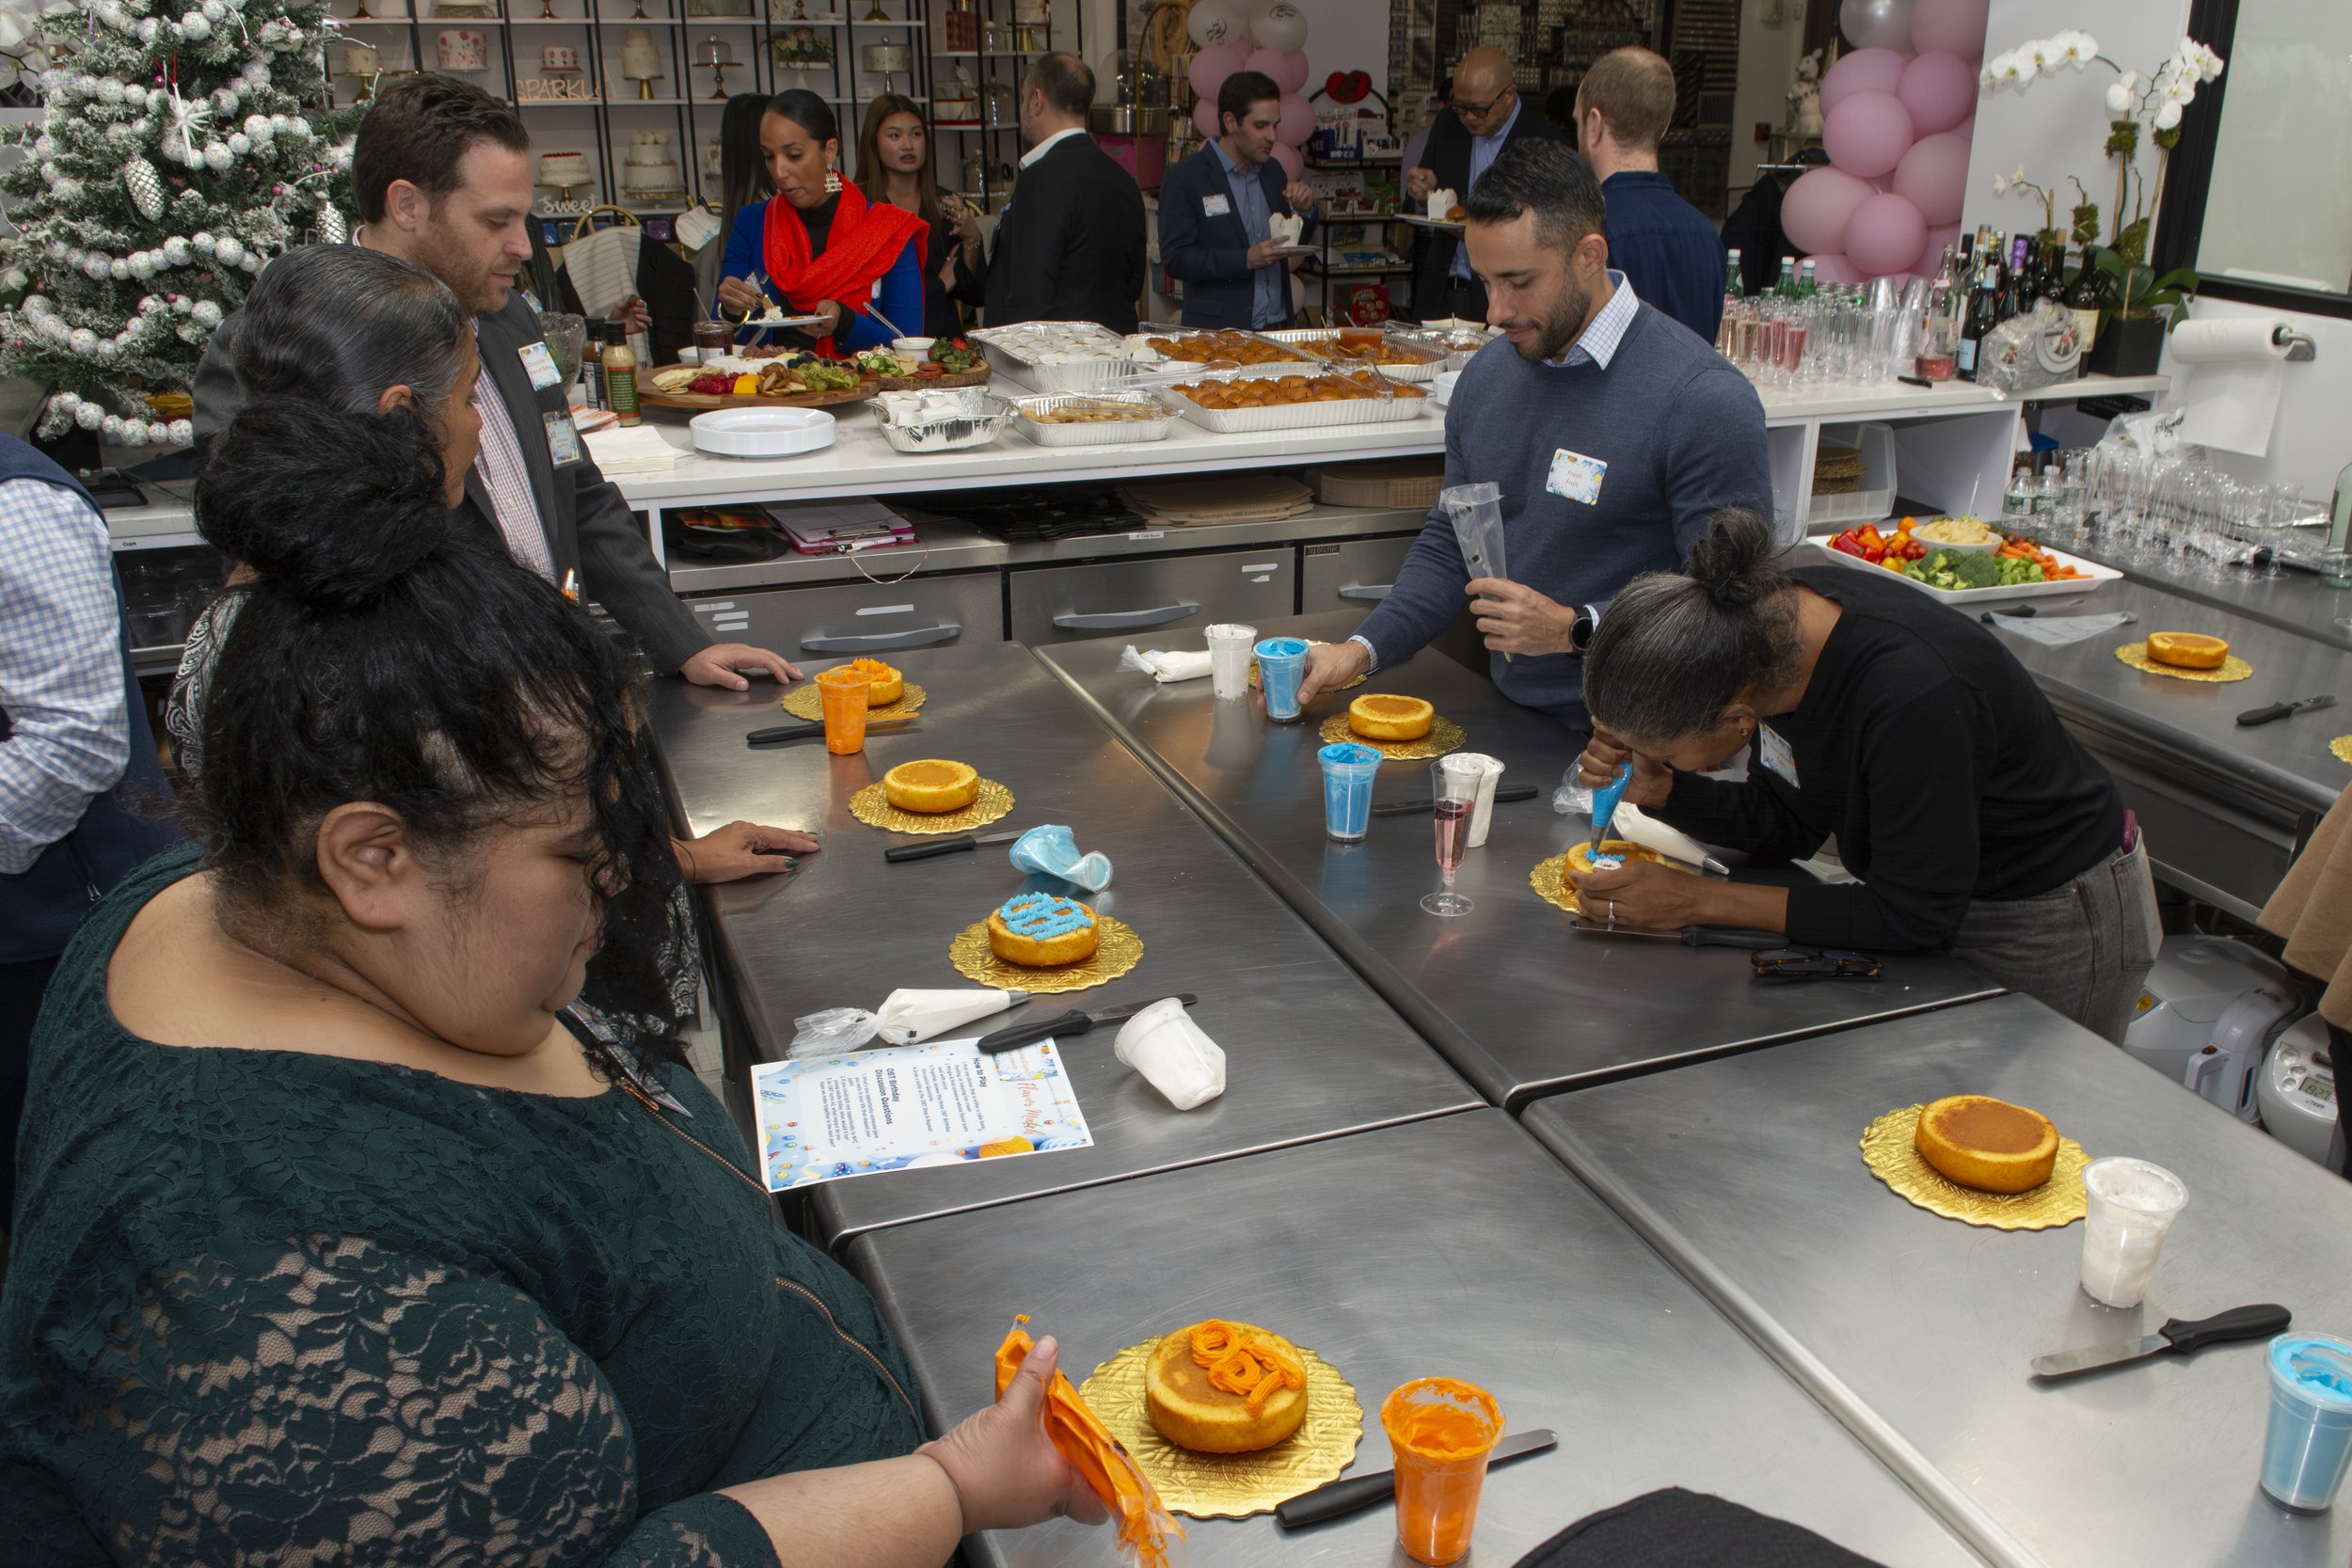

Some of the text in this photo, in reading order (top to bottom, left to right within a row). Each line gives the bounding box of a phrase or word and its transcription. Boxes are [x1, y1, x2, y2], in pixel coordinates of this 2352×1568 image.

[538, 194, 599, 214] Sweet
[971, 1056, 983, 1069] How
[884, 1068, 902, 1102] OBT Birthday
[976, 1075, 989, 1087] Play
[864, 1093, 874, 1114] opportunity
[873, 1069, 895, 1124] Discussion Questions
[1016, 1082, 1038, 1107] Flavor
[846, 1110, 856, 1131] opportunity
[1020, 1108, 1042, 1135] Match
[850, 1135, 859, 1144] NYC
